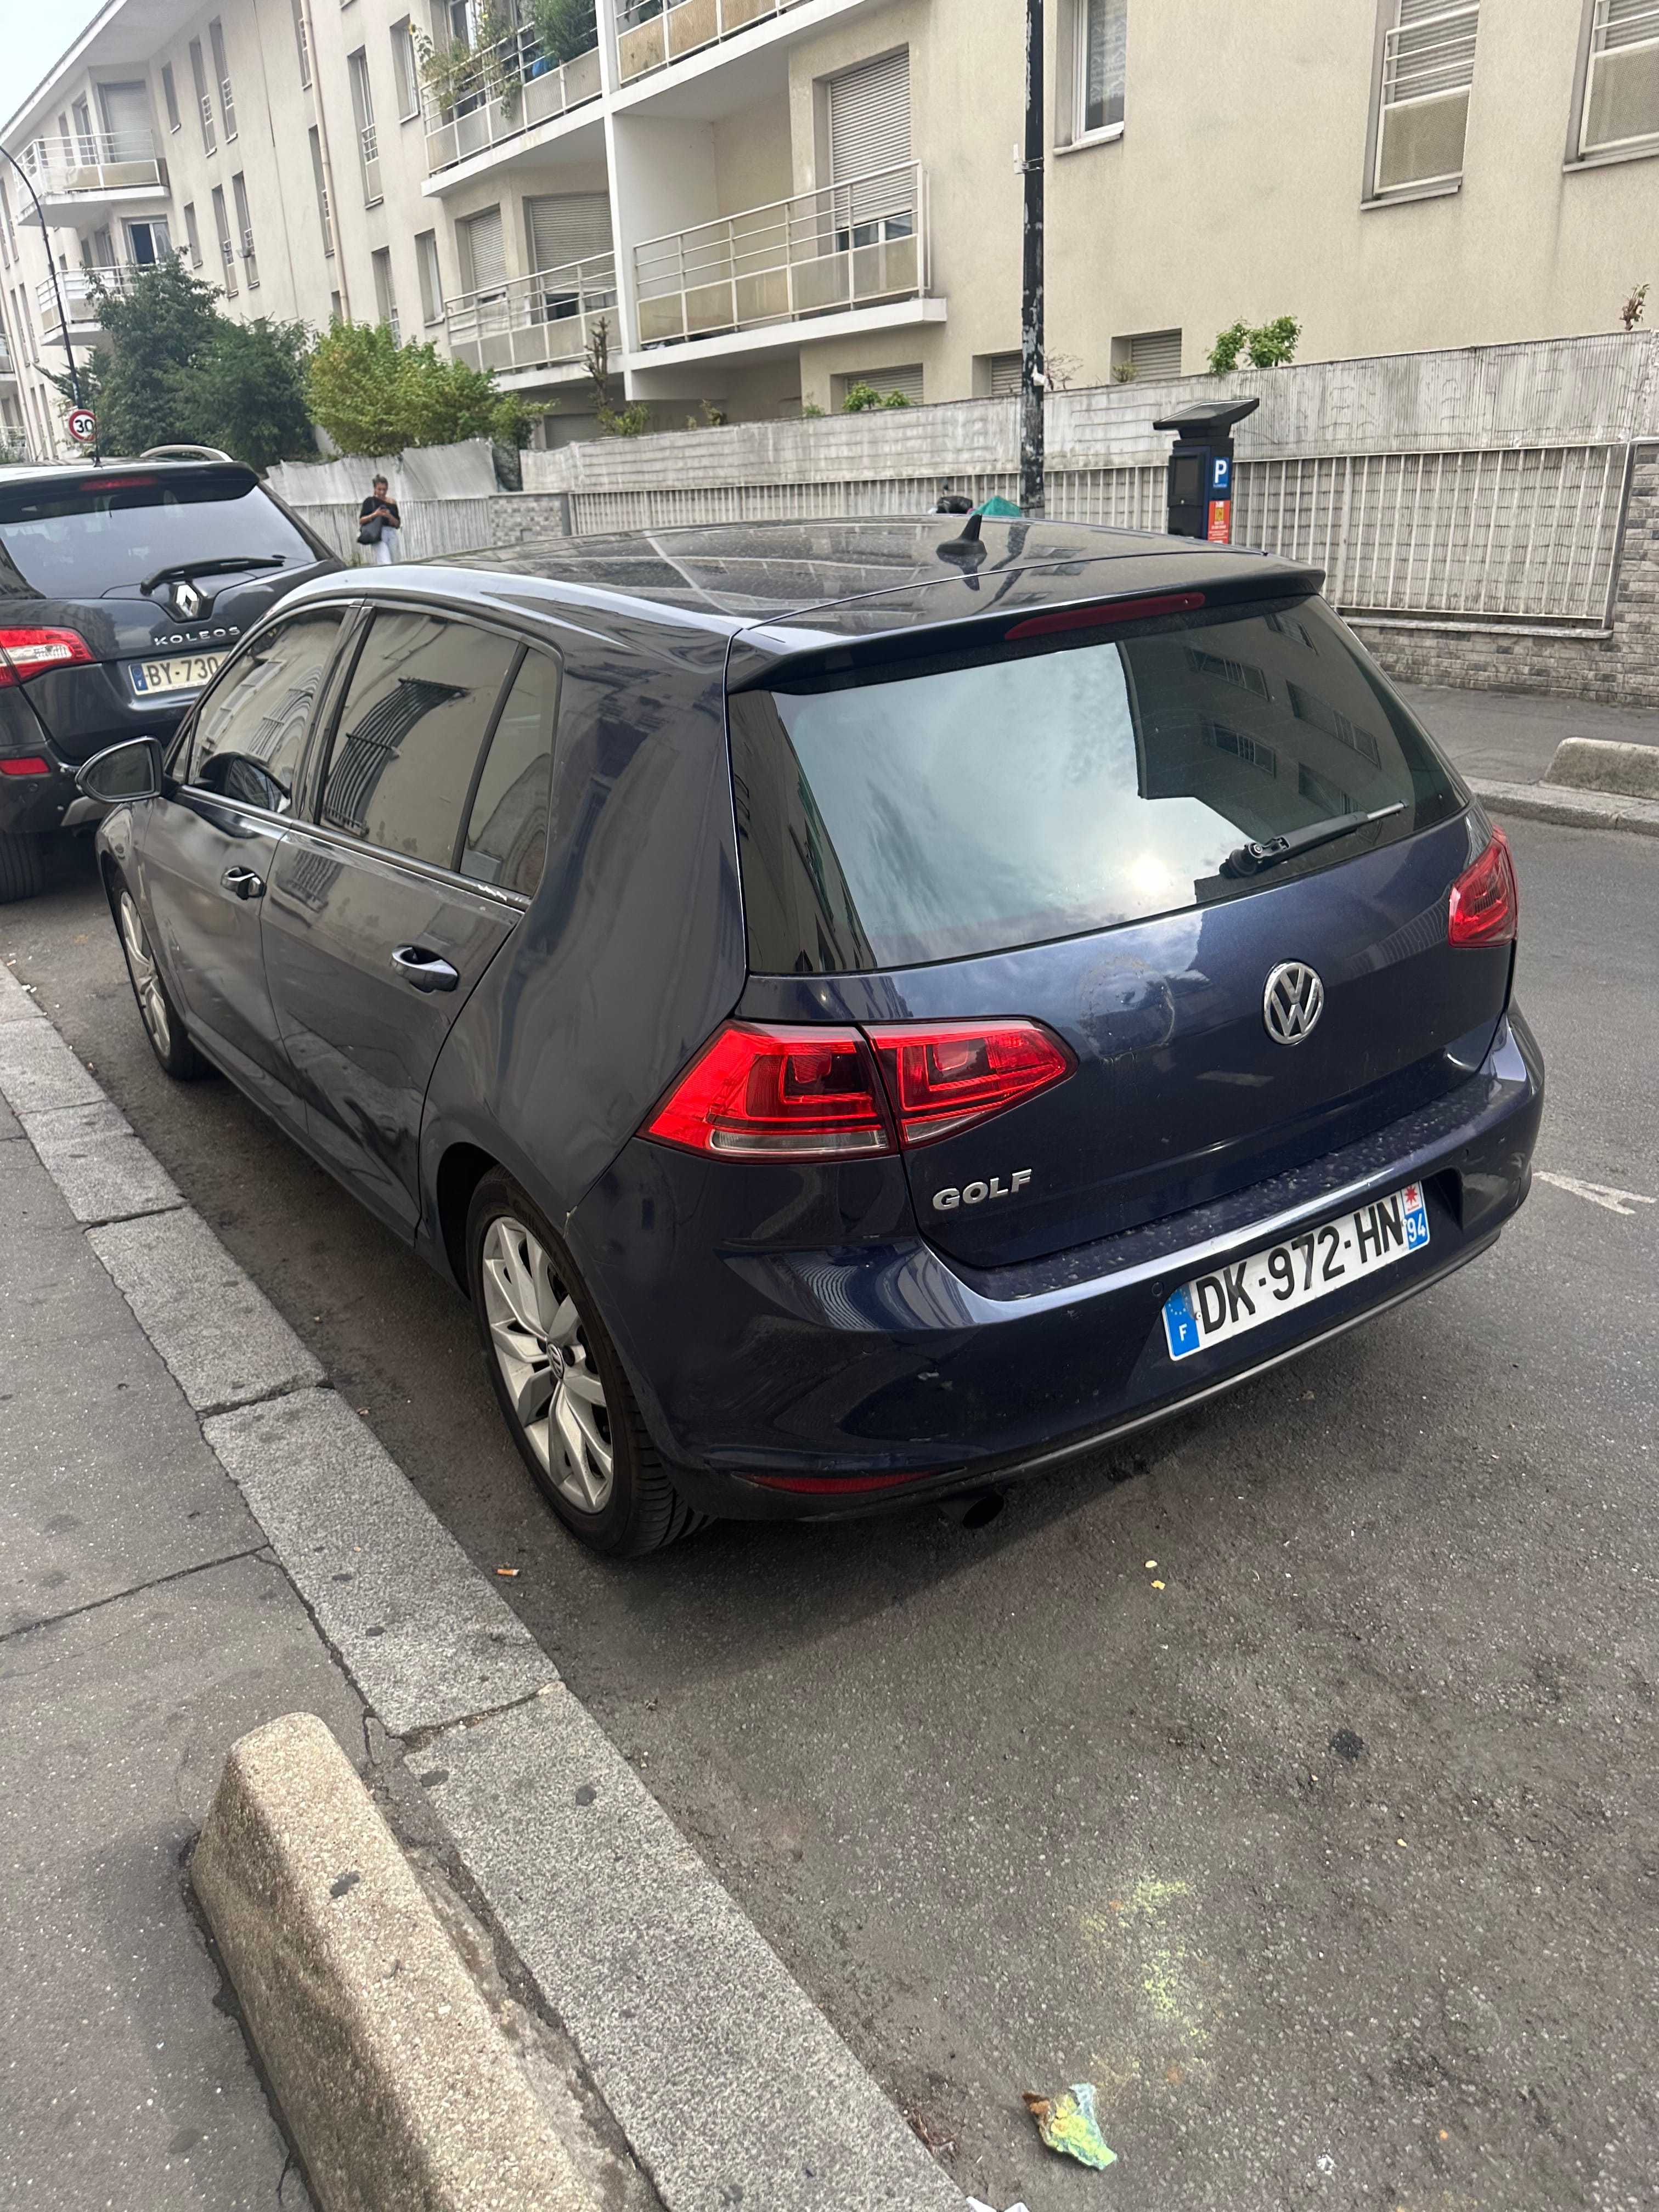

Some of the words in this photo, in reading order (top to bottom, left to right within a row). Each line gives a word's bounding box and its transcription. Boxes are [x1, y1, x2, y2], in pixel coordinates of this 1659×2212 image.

[75, 419, 93, 433] 30
[1214, 460, 1227, 483] P
[154, 626, 240, 646] KOLEOS
[146, 656, 219, 686] BY-730
[932, 1169, 1032, 1210] GOLF
[1407, 1213, 1426, 1243] 94
[1196, 1195, 1404, 1335] DK-972-HN
[1179, 1323, 1187, 1341] F
